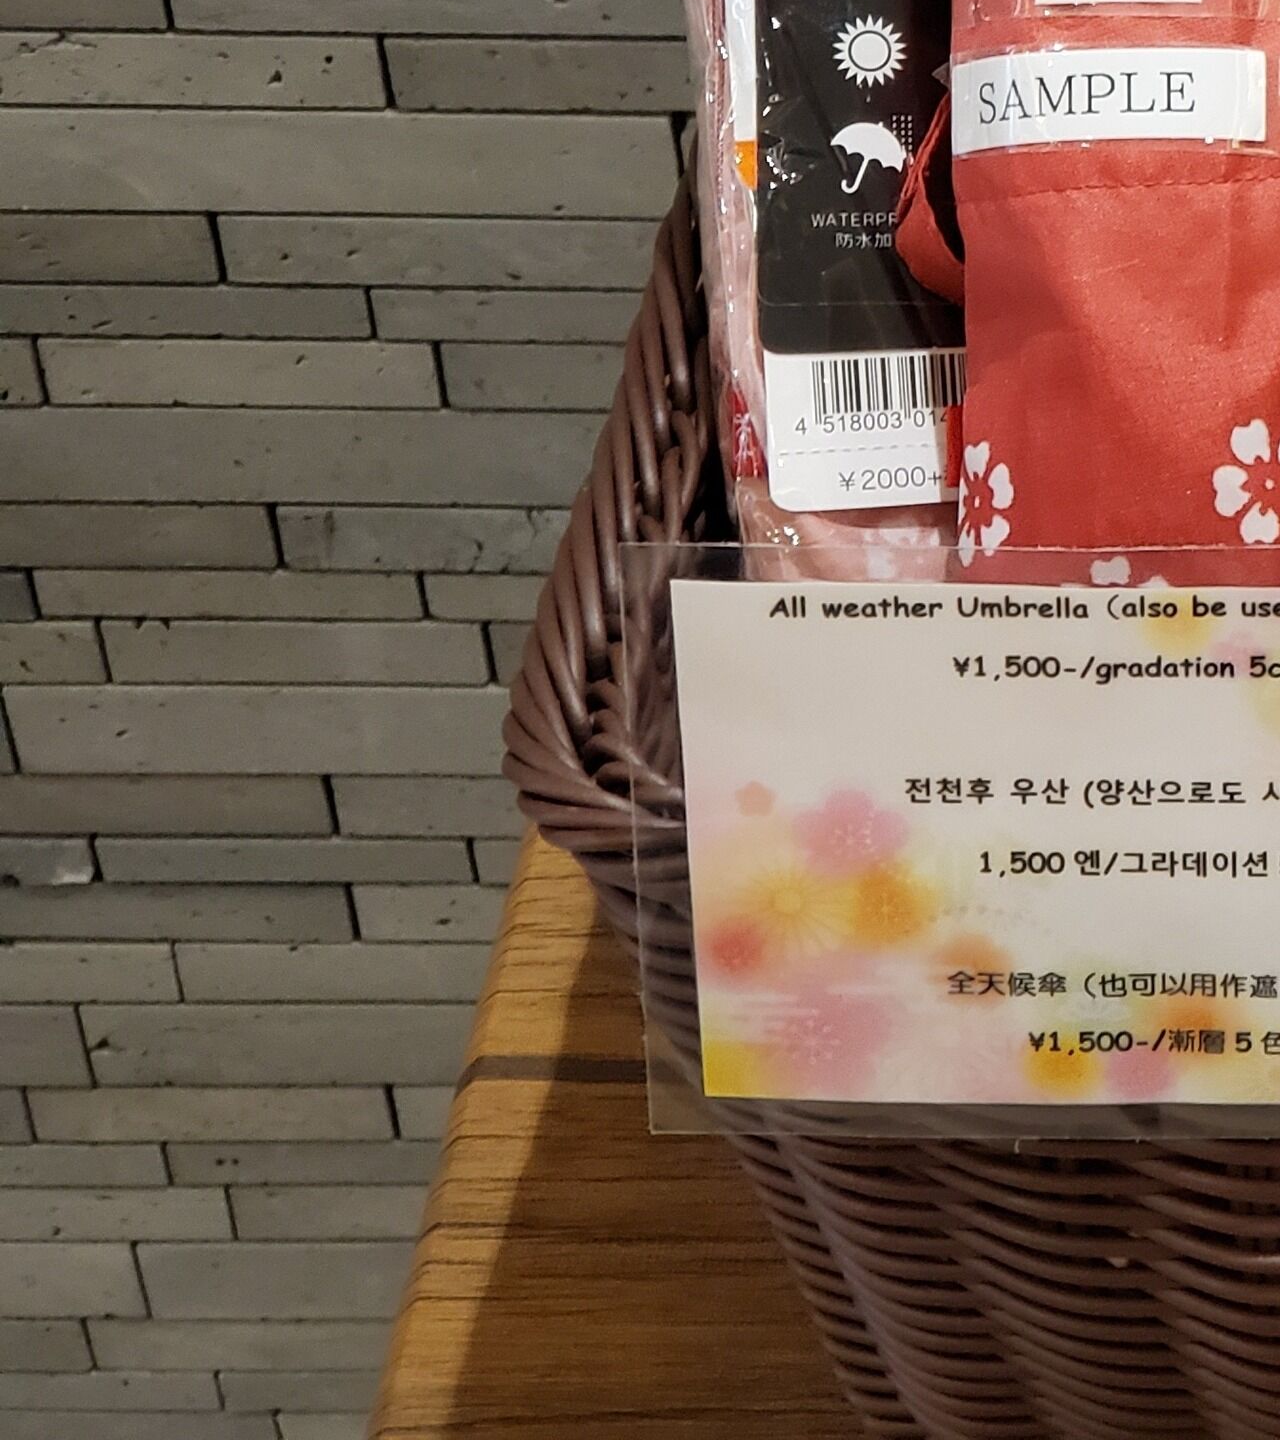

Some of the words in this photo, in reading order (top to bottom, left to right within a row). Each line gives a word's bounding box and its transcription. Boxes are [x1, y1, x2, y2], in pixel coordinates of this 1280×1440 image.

[978, 71, 1197, 125] SAMPLE
[810, 211, 899, 228] WATERPR
[834, 231, 893, 249] 防水加
[794, 417, 808, 435] 4
[822, 411, 903, 434] 518003
[838, 465, 944, 492] ¥2000+
[769, 596, 806, 619] All
[822, 596, 943, 619] weather
[957, 595, 1089, 620] Umbrella
[1191, 595, 1227, 618] be
[952, 654, 1235, 685] ¥1,500-/gradation
[904, 776, 995, 806] 전천후
[1010, 777, 1070, 806] 우산
[1083, 778, 1247, 810] (양산으로도
